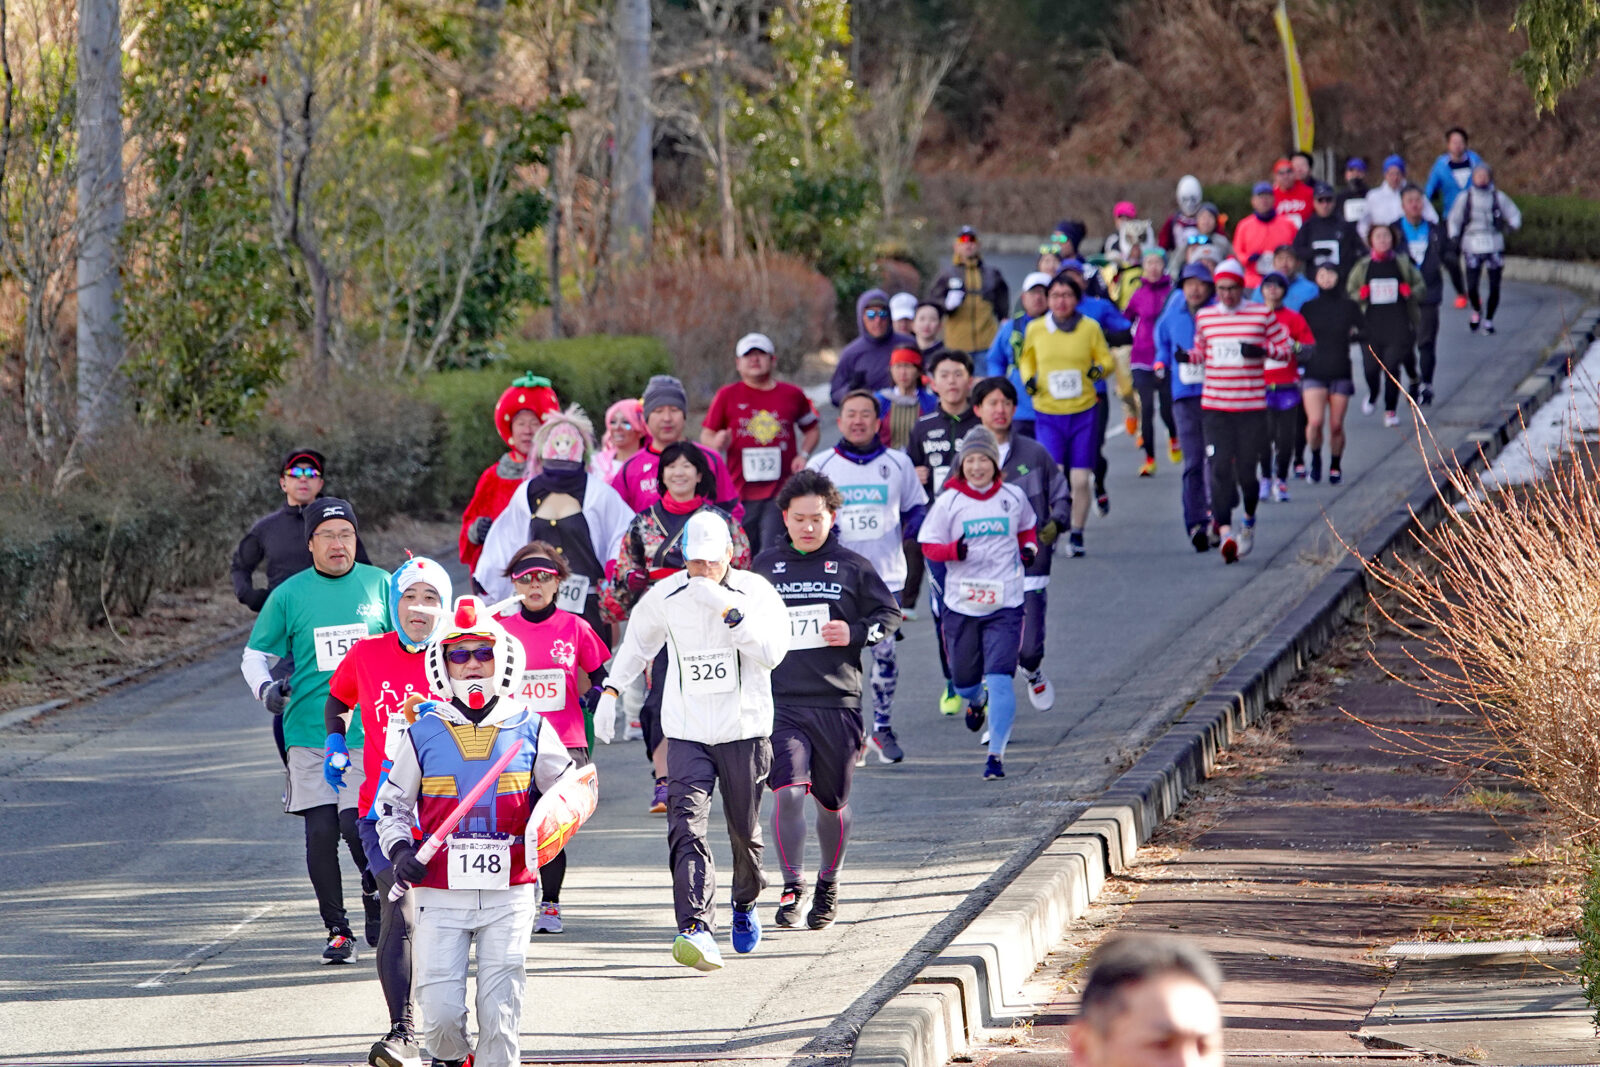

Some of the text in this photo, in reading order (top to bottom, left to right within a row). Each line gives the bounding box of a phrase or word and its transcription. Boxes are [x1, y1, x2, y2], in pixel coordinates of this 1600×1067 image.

[850, 515, 878, 531] 156
[968, 520, 1005, 535] NOVA
[776, 581, 842, 594] ANDBOLD
[967, 588, 997, 605] 223
[690, 661, 727, 681] 326
[521, 682, 558, 699] 405
[459, 853, 502, 874] 148
